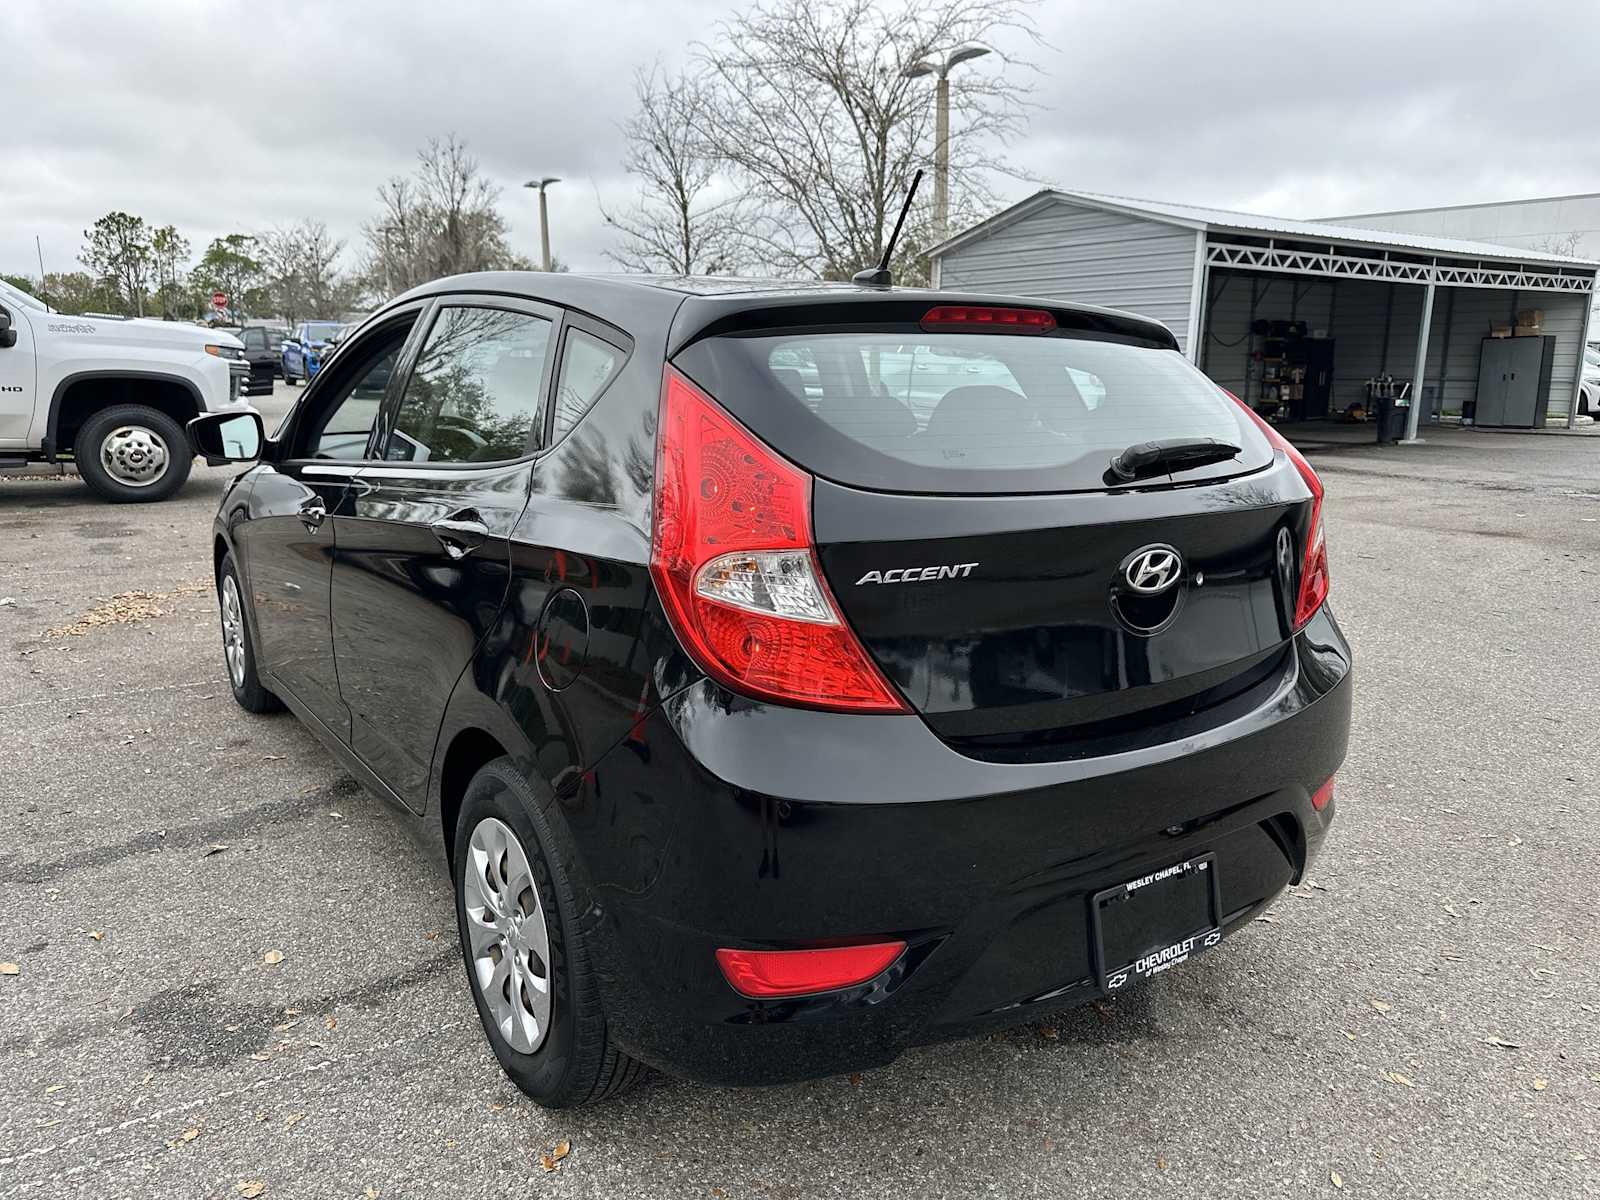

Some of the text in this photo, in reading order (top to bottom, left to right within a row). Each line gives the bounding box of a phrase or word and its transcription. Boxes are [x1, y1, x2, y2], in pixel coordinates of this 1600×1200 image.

[855, 562, 979, 585] ACCENT
[1126, 873, 1154, 891] WESLEY
[1154, 865, 1183, 881] CHAPEL,
[1183, 861, 1191, 870] FL
[1135, 937, 1194, 973] CHEVROLET
